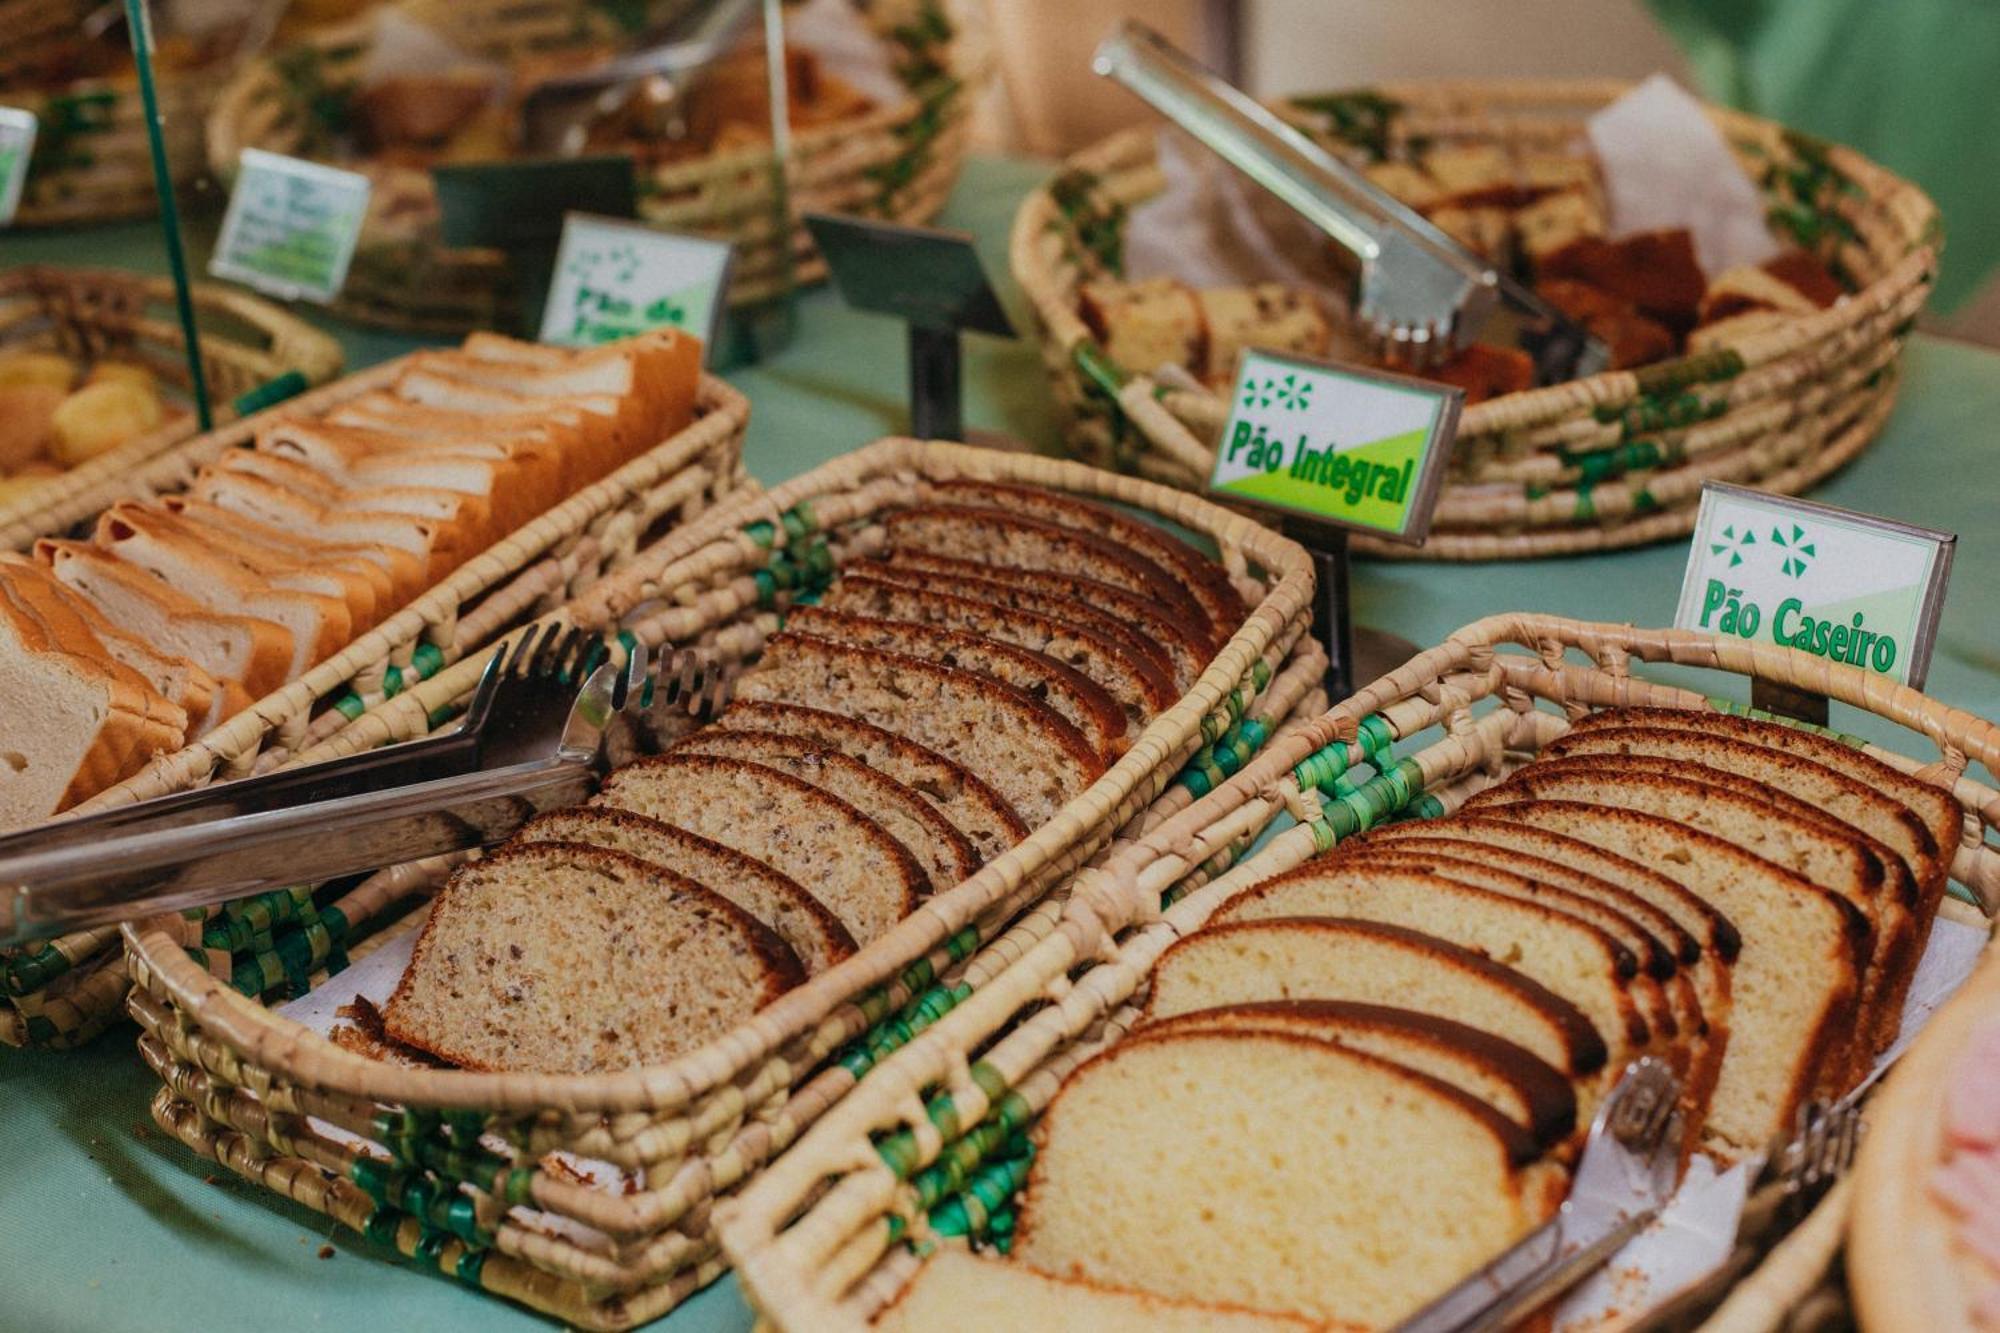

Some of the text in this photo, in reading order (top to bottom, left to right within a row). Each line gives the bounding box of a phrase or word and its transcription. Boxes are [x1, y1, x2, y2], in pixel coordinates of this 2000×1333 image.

[1227, 420, 1414, 506] Pão Integral
[1699, 579, 1896, 673] Pão Caseiro
